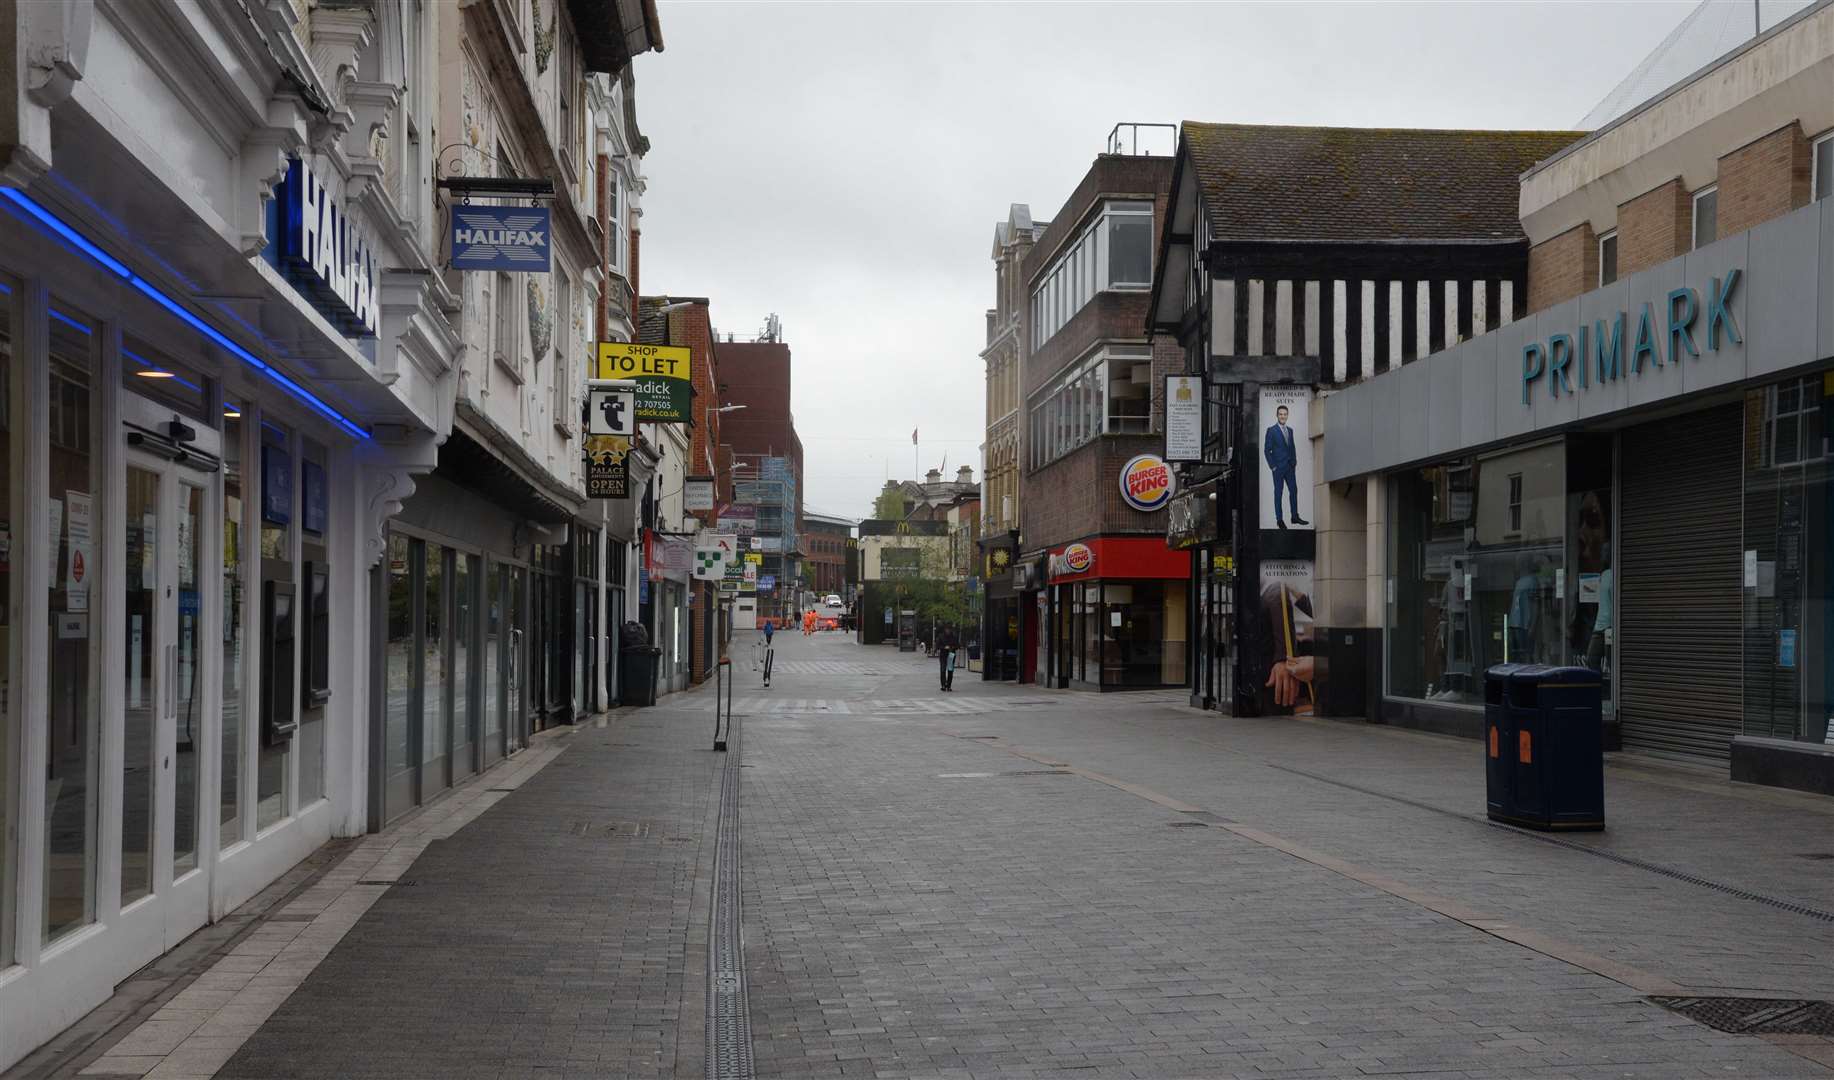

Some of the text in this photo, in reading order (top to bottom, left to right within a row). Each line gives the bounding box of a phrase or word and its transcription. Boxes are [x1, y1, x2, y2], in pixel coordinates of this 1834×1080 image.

[455, 229, 546, 248] HALIFAX
[302, 159, 381, 339] HALIFAX
[1521, 268, 1743, 406] PRIMARK
[627, 346, 658, 356] SHOP
[606, 355, 679, 375] TO LET
[636, 381, 670, 394] adick
[635, 409, 680, 417] radick.co.uk
[1128, 466, 1166, 485] BURGER
[591, 480, 624, 489] OPEN
[1130, 475, 1168, 497] KING
[1070, 553, 1089, 564] KING
[725, 566, 743, 574] ocal
